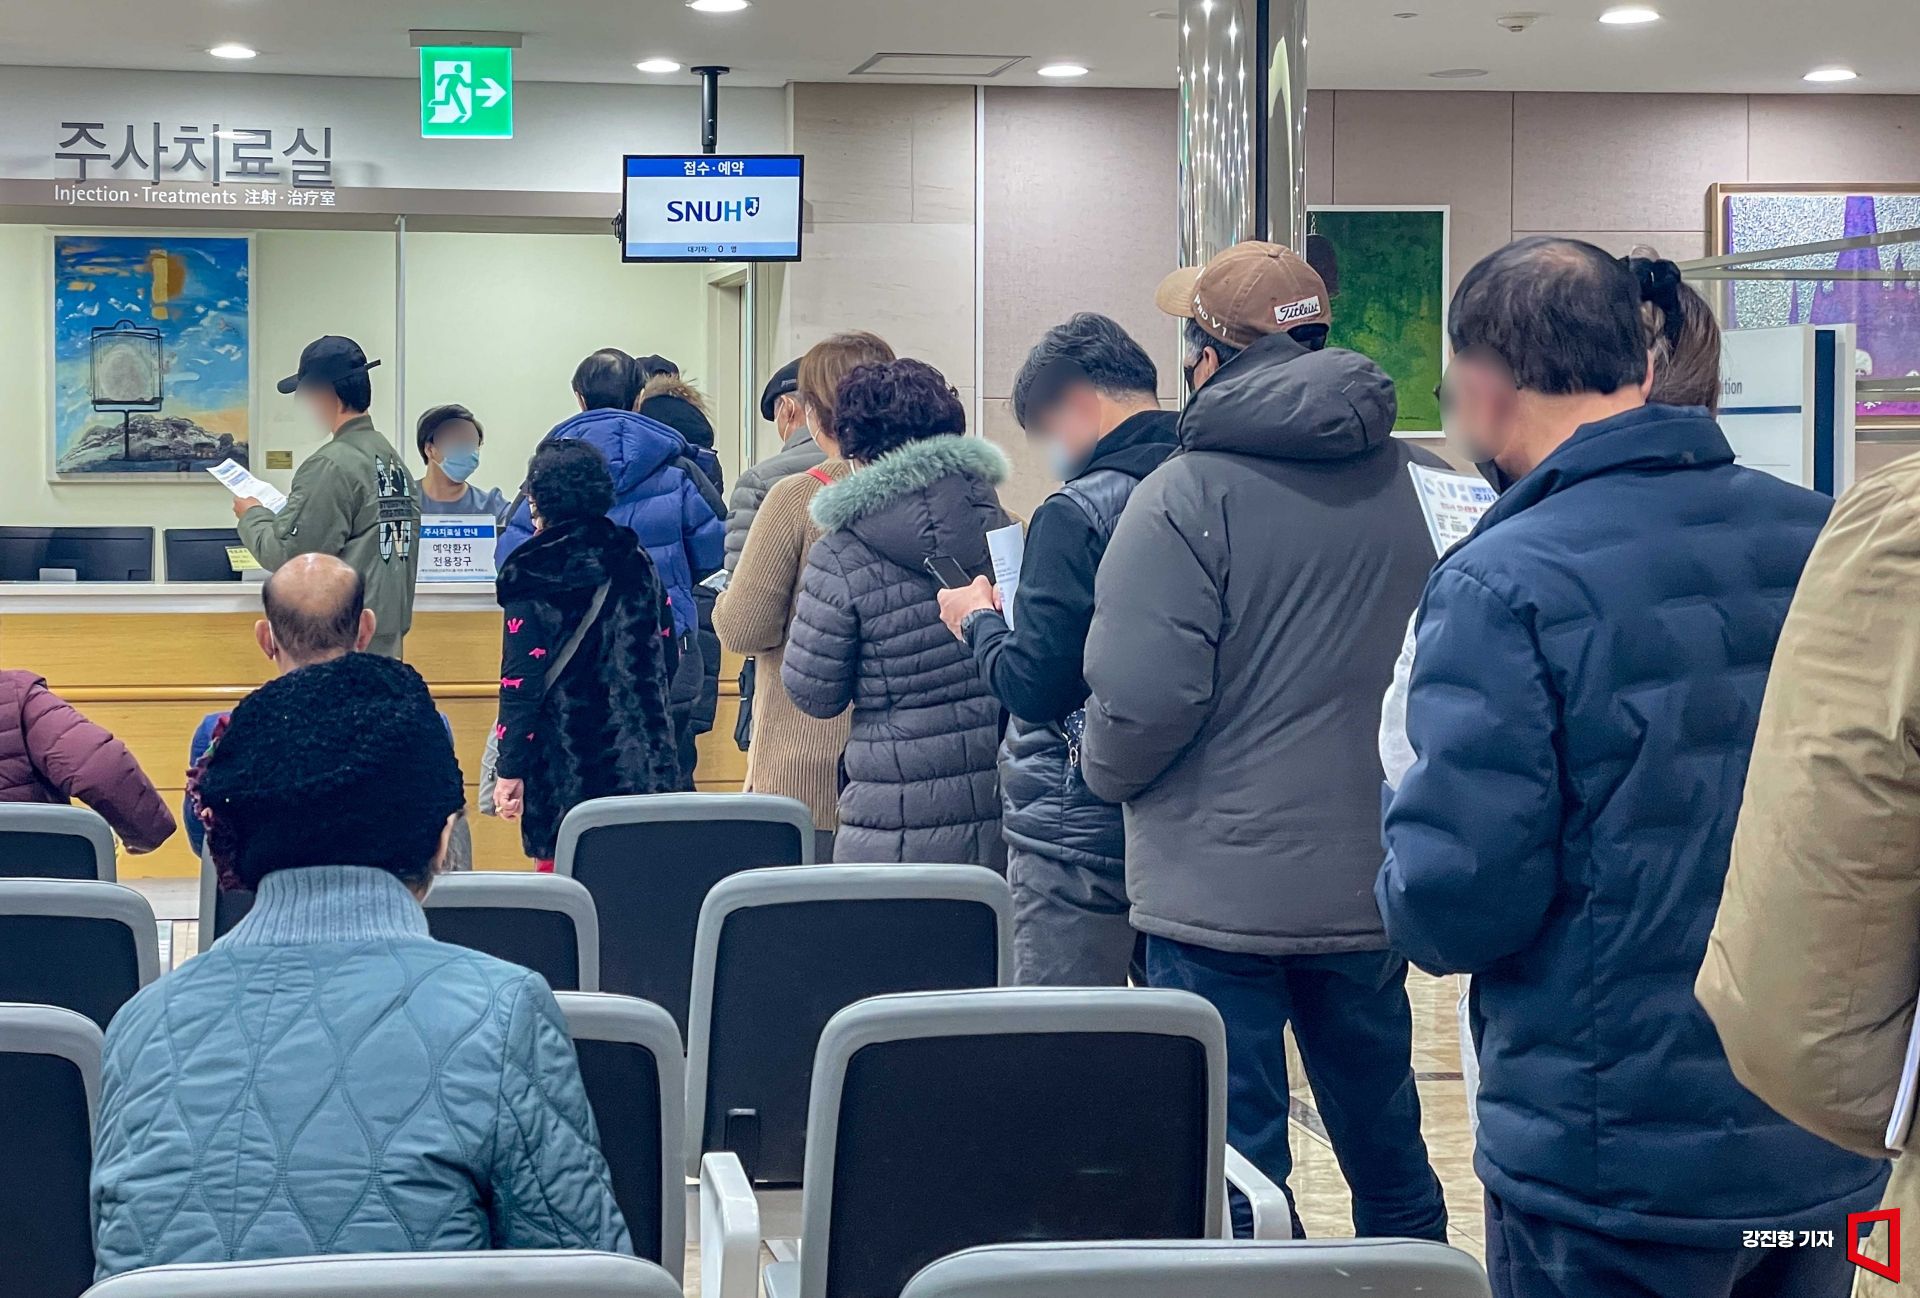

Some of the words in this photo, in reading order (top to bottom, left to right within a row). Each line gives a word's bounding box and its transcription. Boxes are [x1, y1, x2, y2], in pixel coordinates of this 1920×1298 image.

[55, 121, 335, 189] 주사치료실
[667, 200, 742, 222] SNUH
[1277, 302, 1320, 322] Titleist
[1720, 377, 1742, 395] tion
[463, 528, 478, 537] 안내
[432, 543, 472, 553] 예약환자
[433, 556, 472, 567] 전용창구
